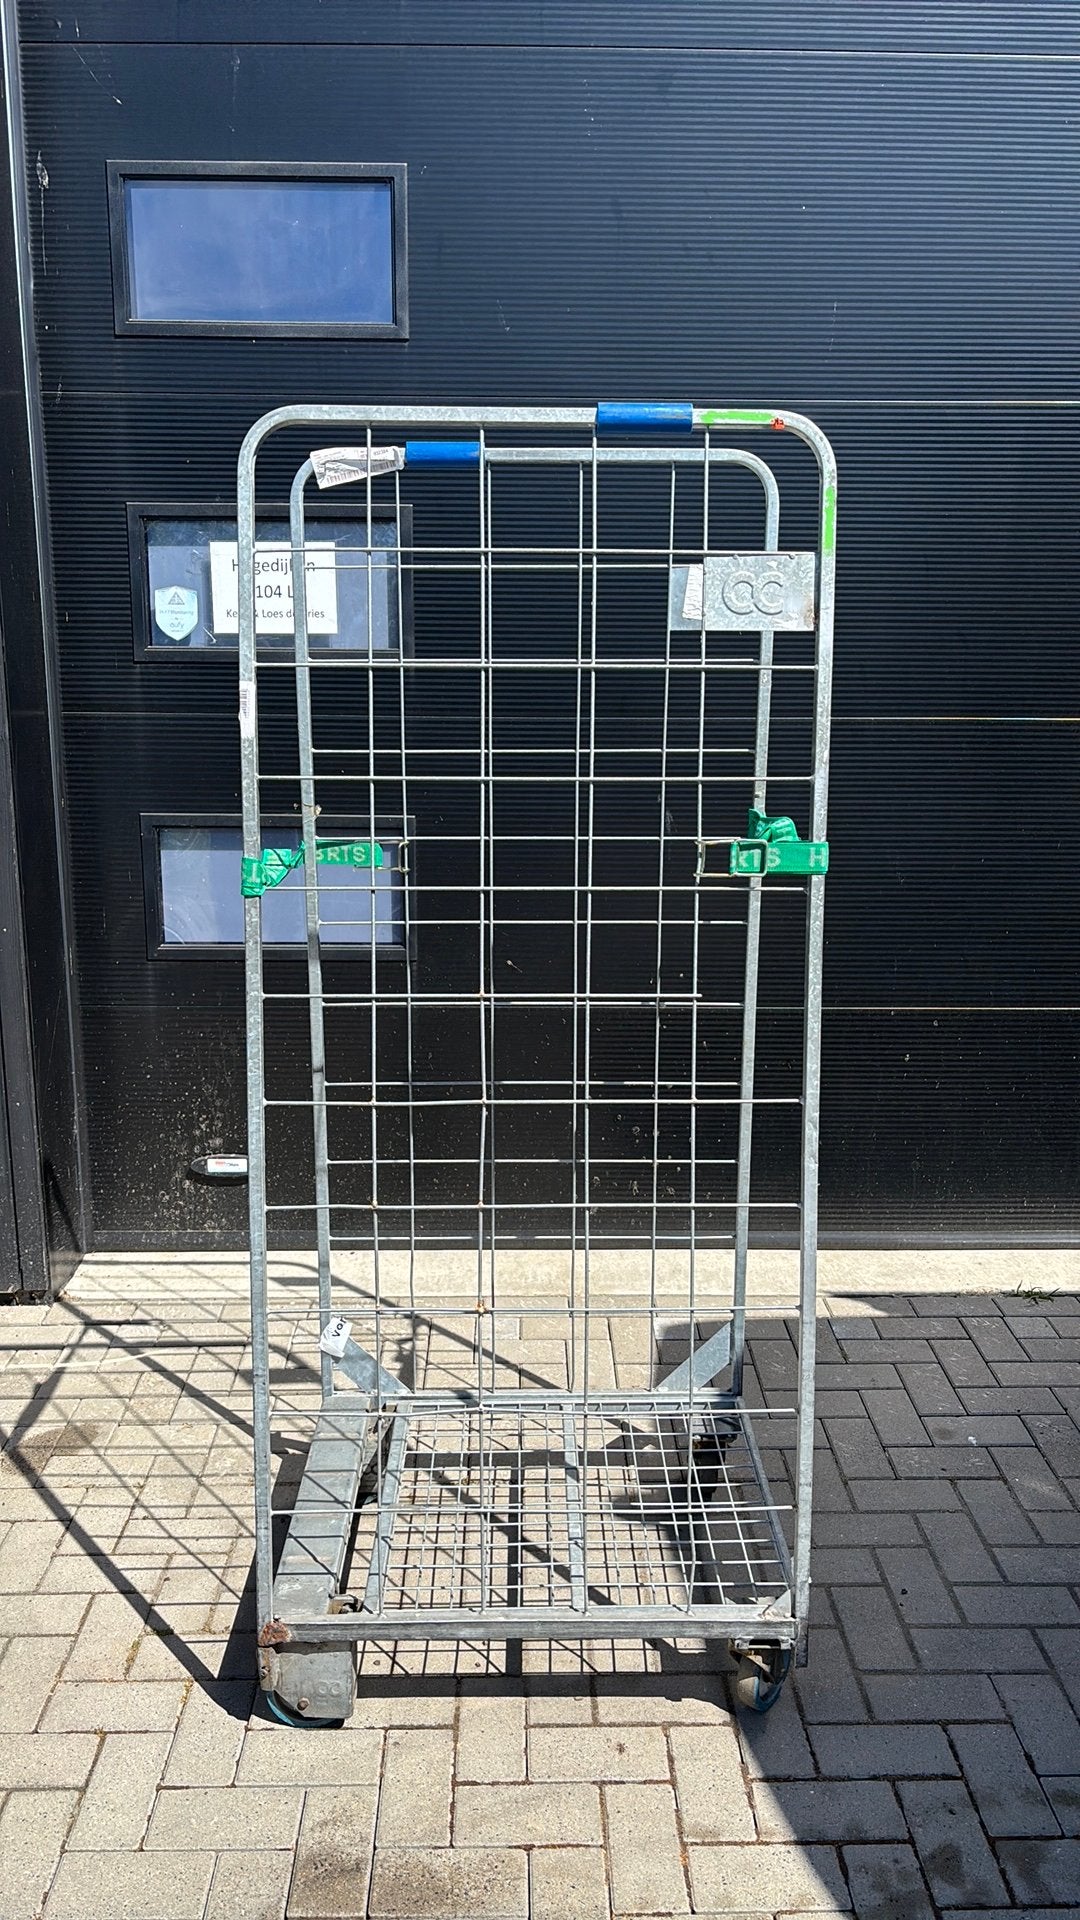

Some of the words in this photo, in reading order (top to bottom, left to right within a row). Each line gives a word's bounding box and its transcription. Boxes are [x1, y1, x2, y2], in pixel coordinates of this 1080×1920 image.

[253, 585, 283, 598] 104
[262, 608, 284, 618] Loes
[306, 608, 325, 618] ries
